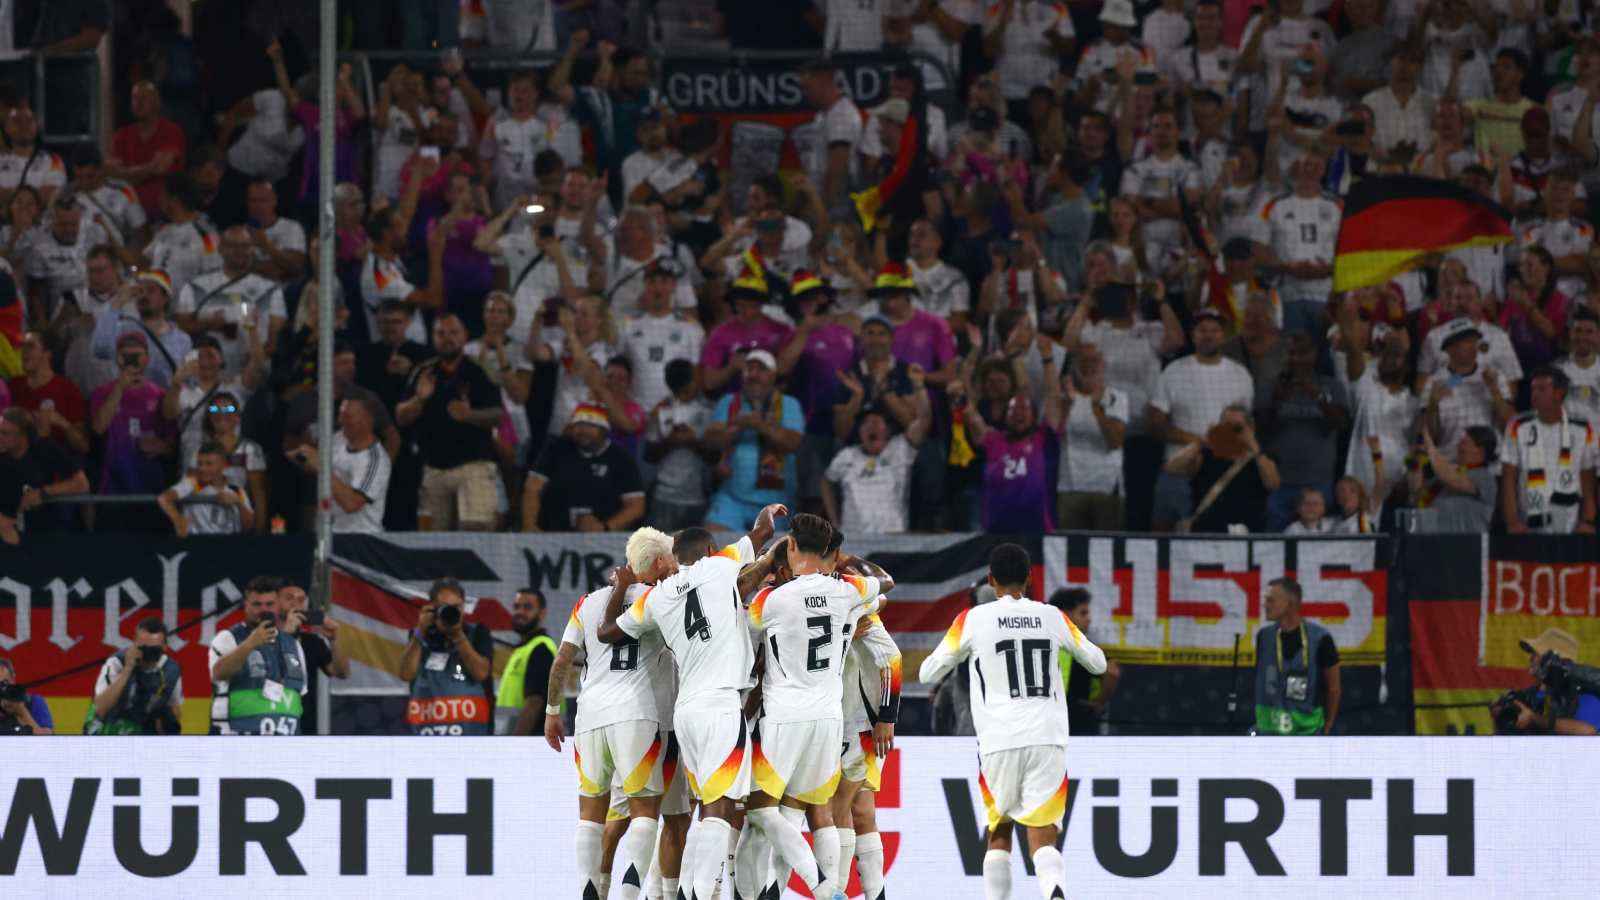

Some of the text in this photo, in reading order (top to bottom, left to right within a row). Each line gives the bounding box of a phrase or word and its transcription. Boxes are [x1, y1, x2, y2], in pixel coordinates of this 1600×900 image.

[668, 65, 896, 107] GRÜNSAD
[684, 588, 712, 641] 4
[804, 596, 828, 609] KOCH
[997, 616, 1042, 629] MUSIALA
[807, 615, 832, 672] 2
[995, 638, 1051, 698] 10
[408, 699, 476, 721] PHOTO
[0, 777, 494, 878] WÜRTH
[941, 777, 1475, 878] WÜRTH
